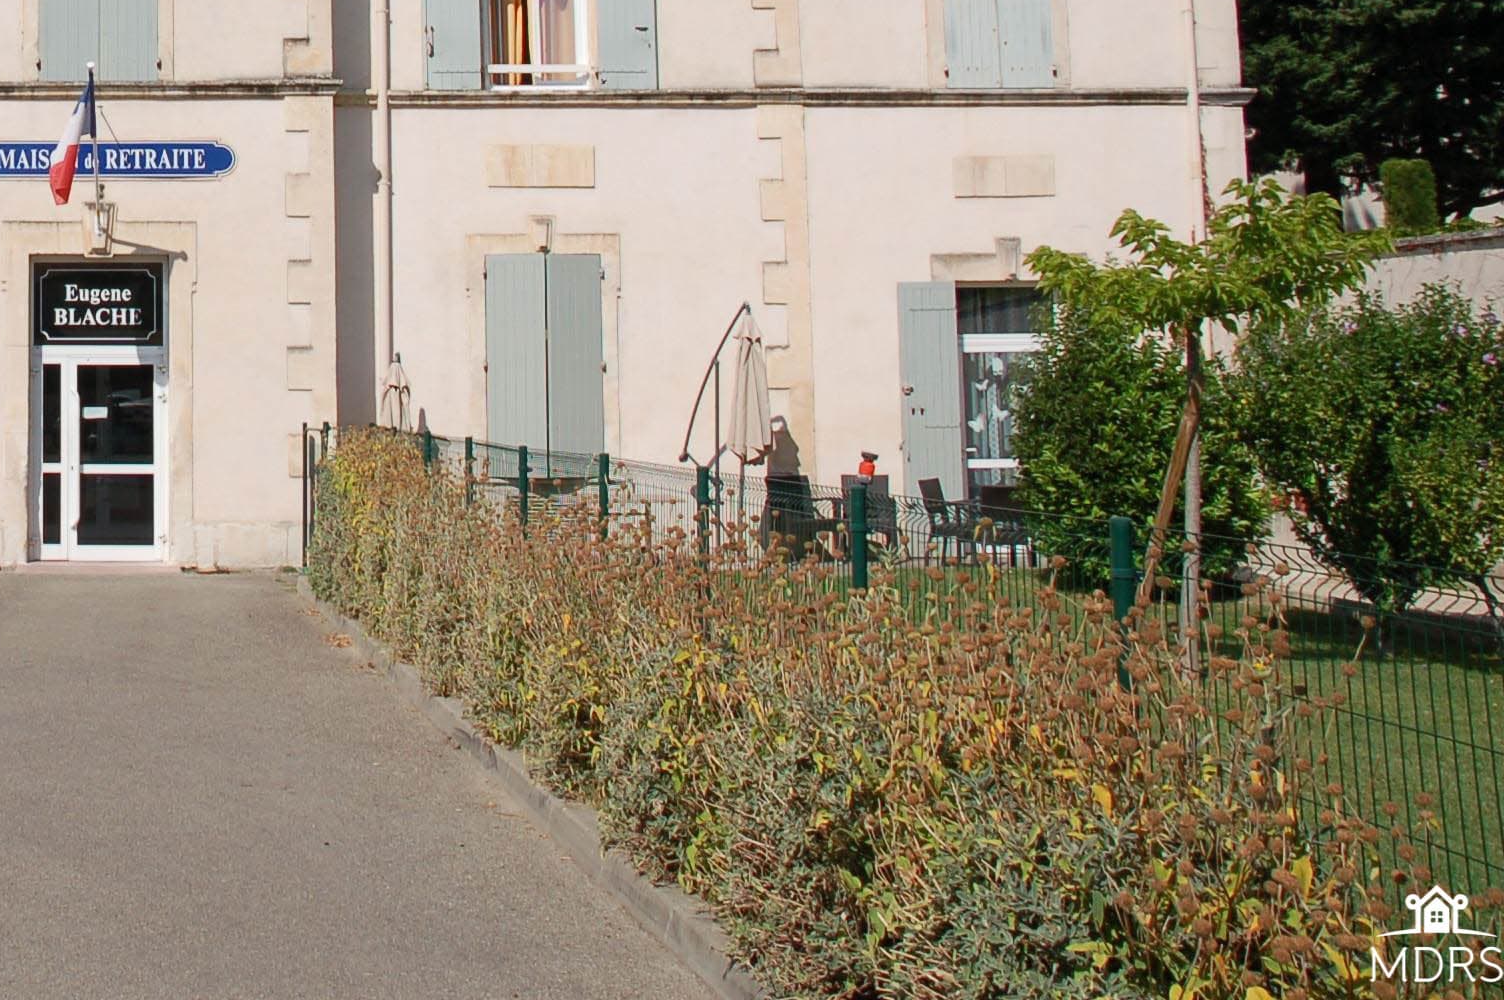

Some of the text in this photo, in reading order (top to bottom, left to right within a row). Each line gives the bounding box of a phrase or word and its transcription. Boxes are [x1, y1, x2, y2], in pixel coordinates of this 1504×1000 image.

[105, 149, 206, 169] RETRAITE
[64, 284, 132, 305] Eugene
[54, 308, 142, 326] BLACHE
